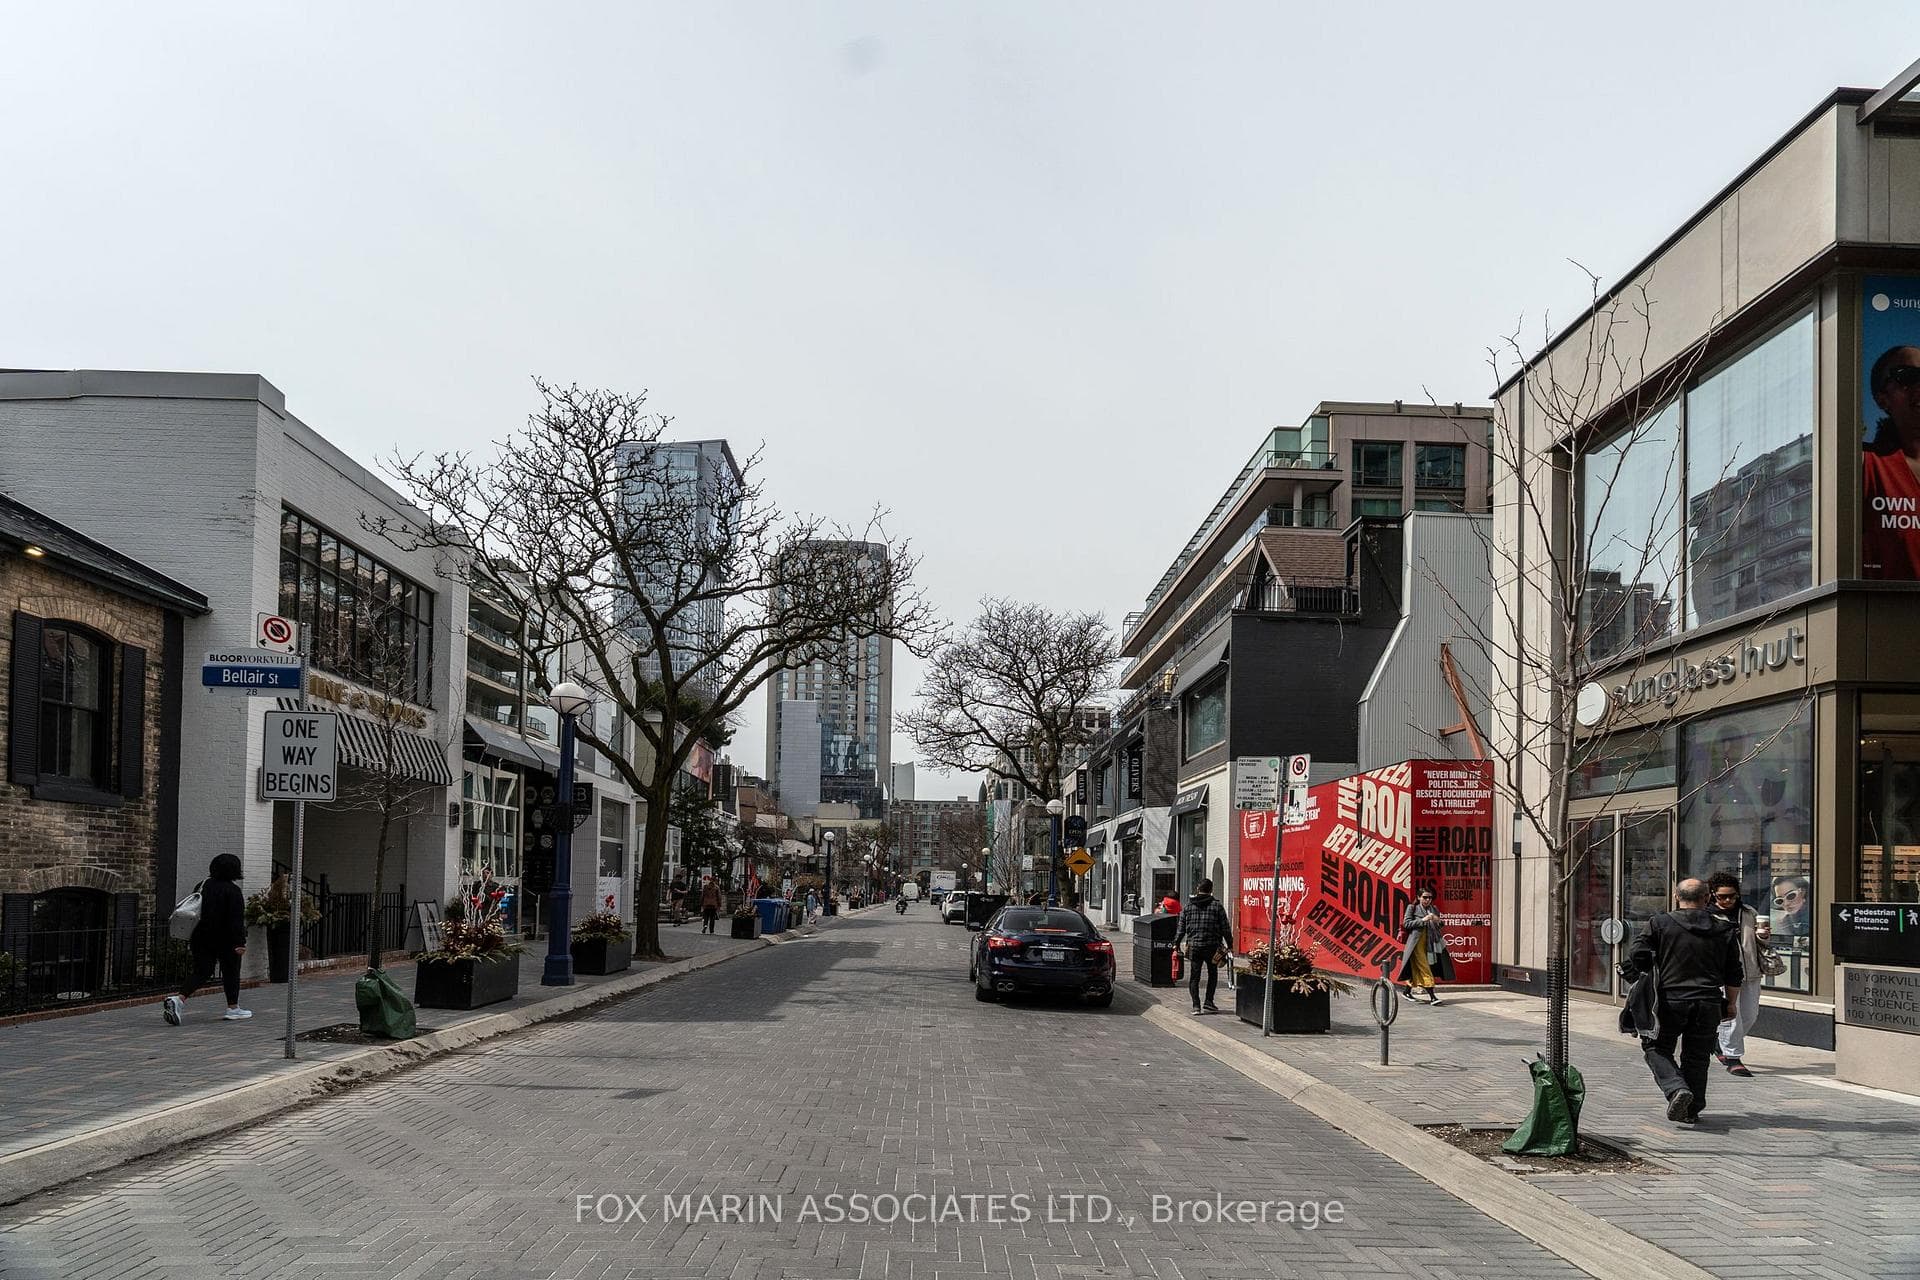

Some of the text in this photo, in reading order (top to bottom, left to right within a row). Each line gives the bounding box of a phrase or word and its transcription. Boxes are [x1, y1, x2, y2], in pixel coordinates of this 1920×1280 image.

[1872, 496, 1916, 511] OWN
[209, 654, 297, 665] BLOORYORKVILLE
[1612, 625, 1805, 707] sunglass hut
[222, 668, 279, 684] Bellair St
[246, 688, 258, 696] 28
[282, 718, 319, 739] ONE
[281, 745, 318, 766] WAY
[1449, 770, 1468, 780] MIND
[266, 772, 331, 793] BEGINS
[1415, 789, 1491, 799] RESCUE DOCUMENTARY
[1431, 799, 1438, 807] IS
[1415, 826, 1492, 853] THE ROAD
[1322, 823, 1406, 877] BETWEEN
[1415, 855, 1491, 877] BETWEEN
[1243, 876, 1305, 892] NOW STRAMING
[1248, 895, 1260, 907] Gem
[1320, 850, 1411, 943] THE ROAD
[1445, 889, 1473, 900] RESCUE
[1853, 908, 1896, 916] Pedestrian
[1853, 916, 1889, 924] Entrance
[1307, 899, 1383, 958] BETWEEN
[1442, 933, 1478, 946] Gem
[1464, 950, 1482, 958] video
[1864, 987, 1914, 1001] PRIVATE
